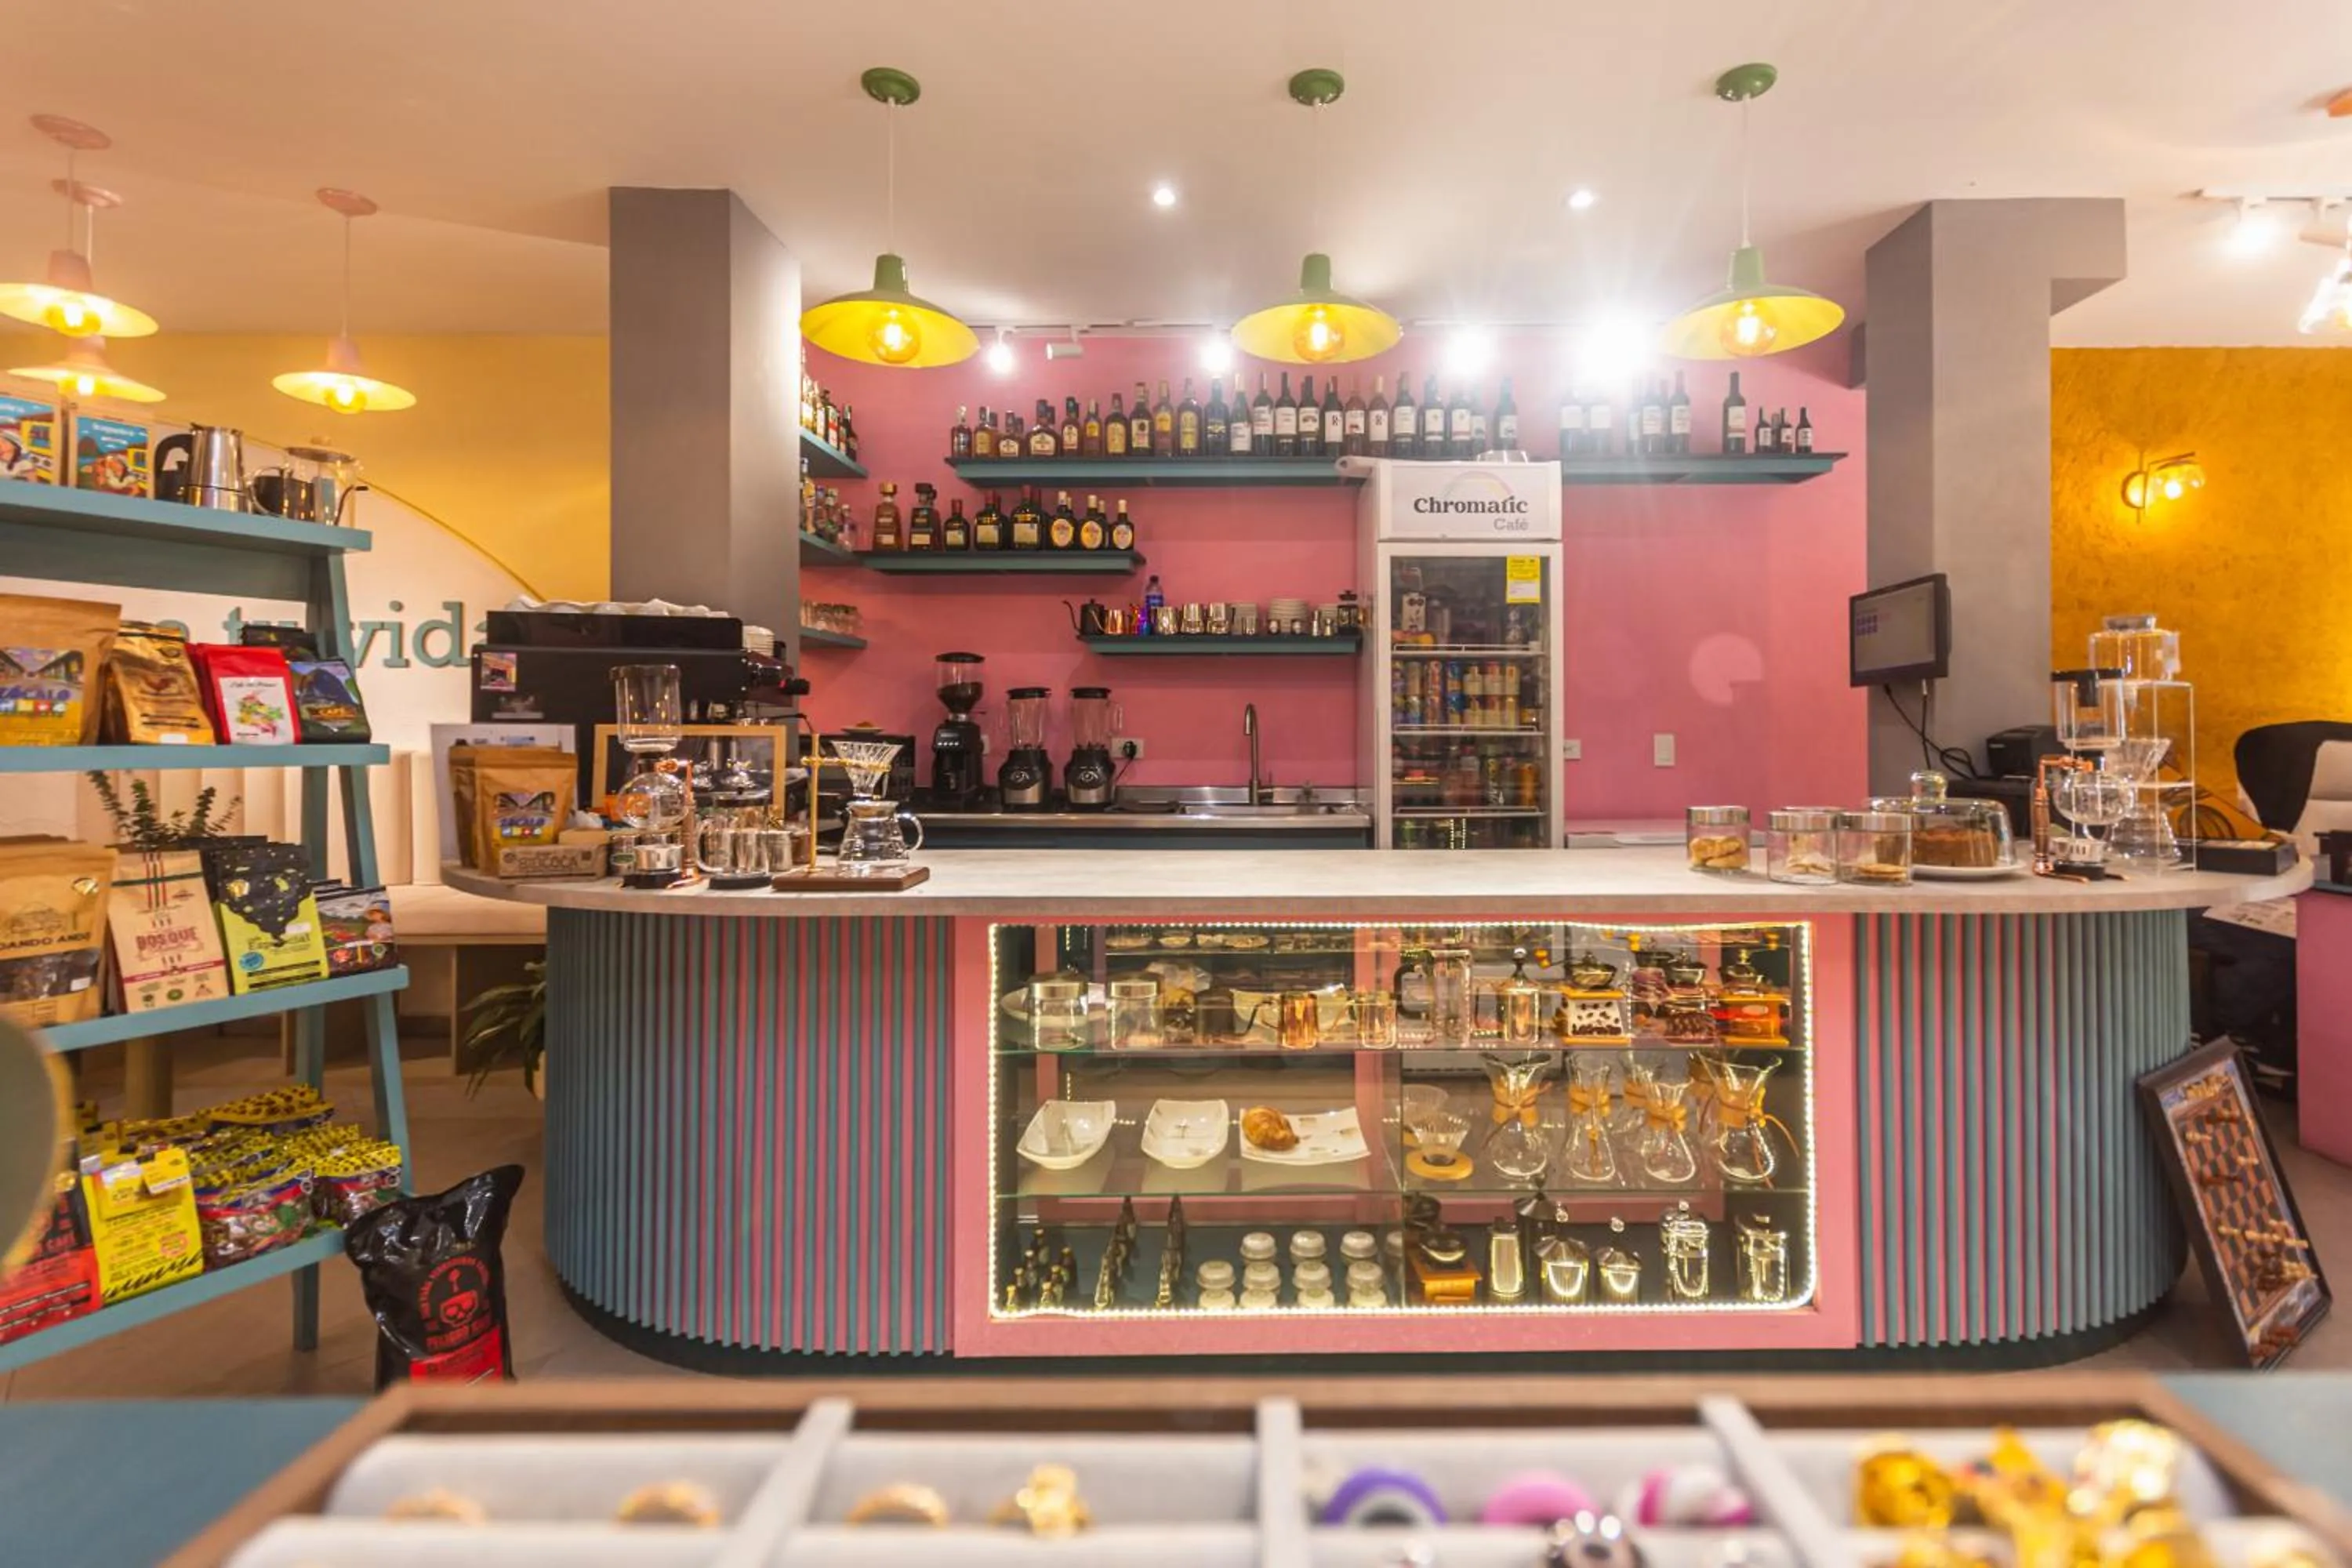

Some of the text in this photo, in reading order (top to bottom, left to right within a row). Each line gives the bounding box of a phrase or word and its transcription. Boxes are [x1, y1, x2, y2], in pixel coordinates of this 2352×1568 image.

[1414, 495, 1528, 514] Chromatic
[1493, 517, 1529, 531] Café
[350, 600, 488, 668] vid
